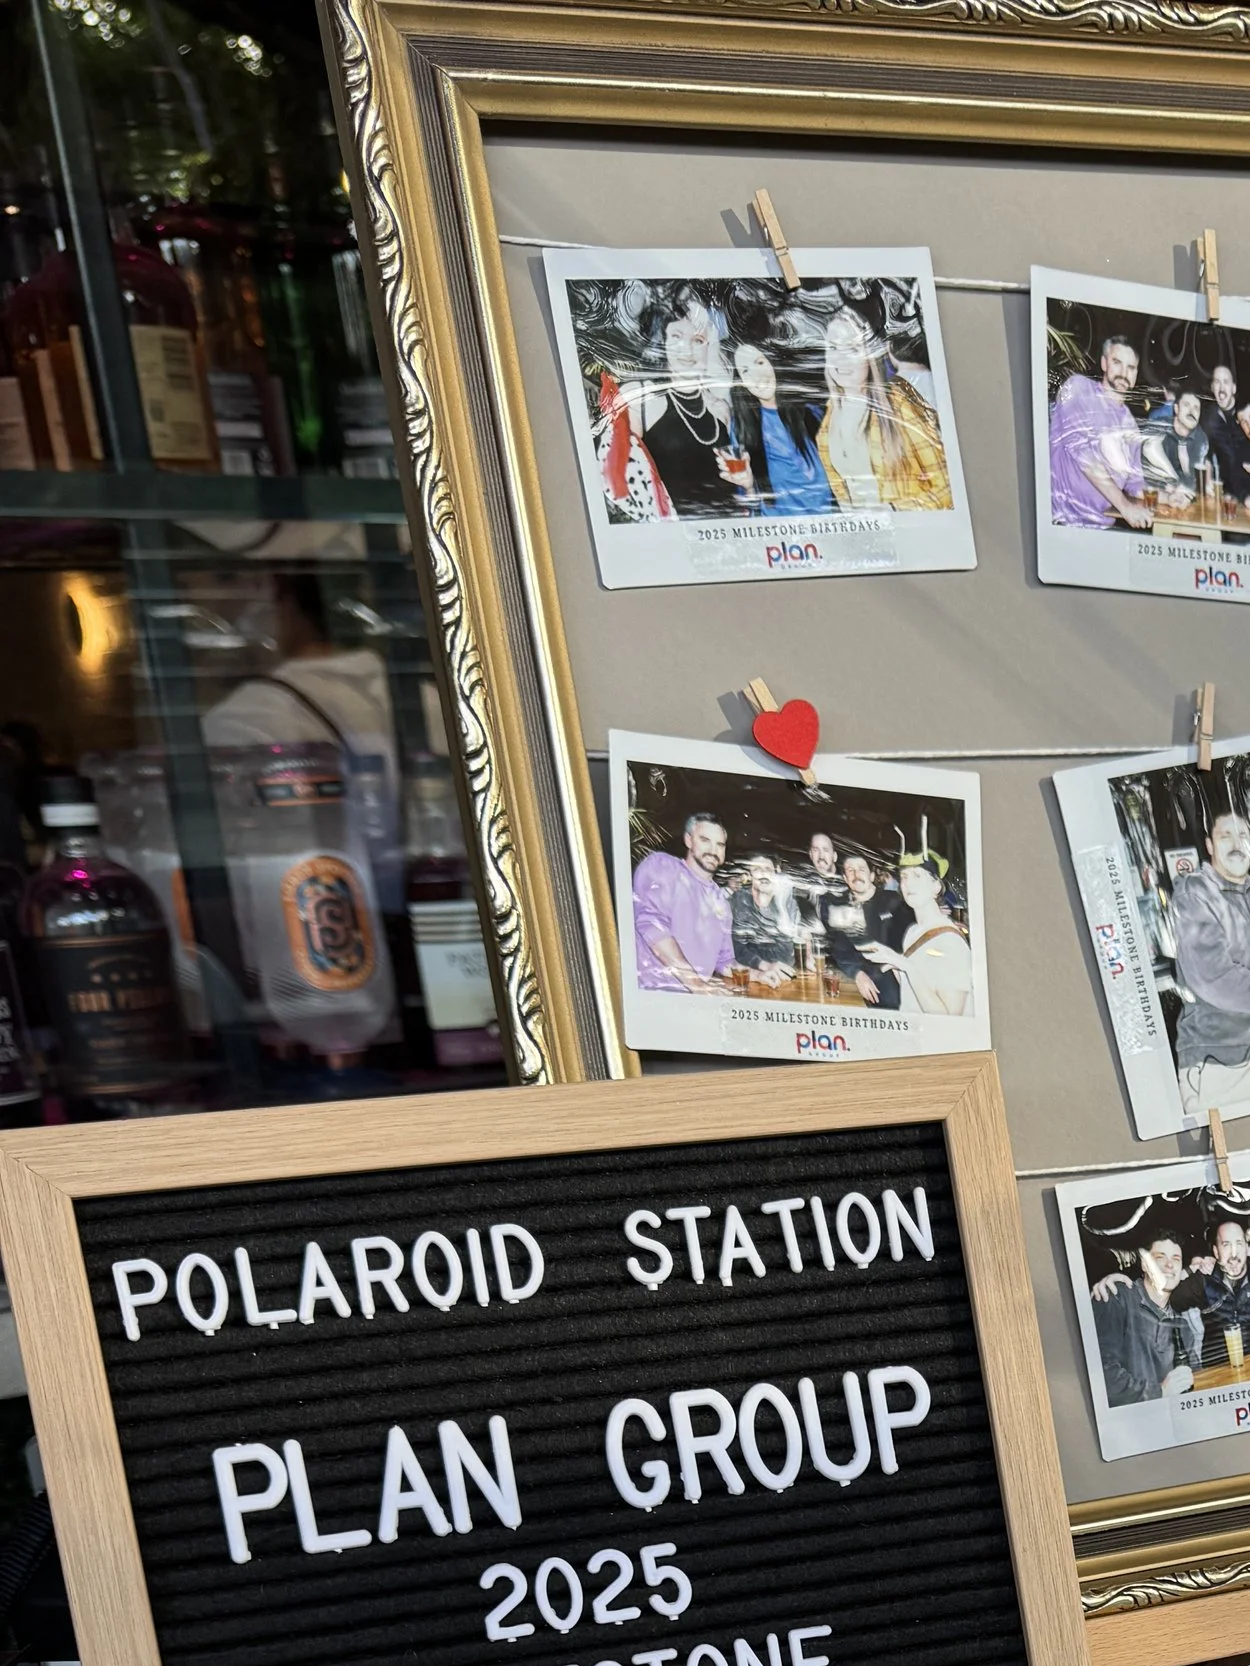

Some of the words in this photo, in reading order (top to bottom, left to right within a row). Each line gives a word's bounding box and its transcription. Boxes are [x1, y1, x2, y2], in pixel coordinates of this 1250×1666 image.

[1138, 544, 1163, 556] 2025
[1168, 547, 1232, 563] MILESTONE
[1106, 857, 1120, 884] 2025
[1114, 890, 1140, 962] MILESTONE
[1132, 966, 1156, 1036] BIRTHDAYS
[731, 1009, 760, 1021] 2025
[764, 1012, 837, 1026] MILESTONE
[842, 1017, 910, 1031] BIRTHDAYS
[112, 1222, 546, 1341] POLAROID
[624, 1186, 935, 1290] STATION
[1180, 1398, 1204, 1410] 2025
[211, 1414, 523, 1563] PLAN
[606, 1365, 933, 1512] GROUP
[479, 1542, 693, 1642] 2025
